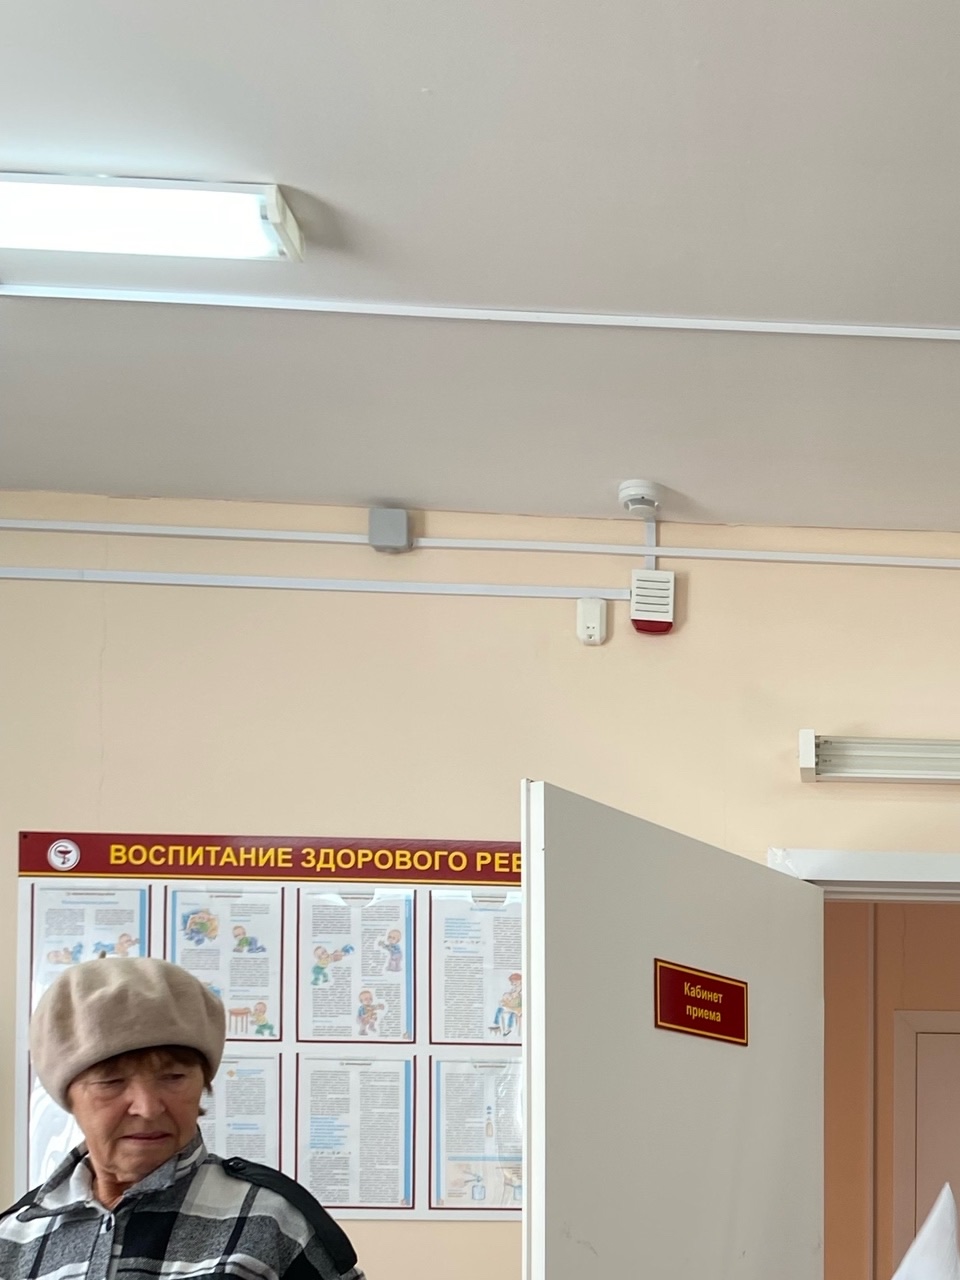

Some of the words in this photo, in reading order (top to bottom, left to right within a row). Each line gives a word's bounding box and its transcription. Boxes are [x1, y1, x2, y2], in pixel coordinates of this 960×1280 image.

[109, 844, 294, 868] ВОСПИТАНИЕ
[301, 847, 468, 873] ЗДОРОВОГО
[684, 981, 723, 1004] Кабинет
[686, 1004, 721, 1022] приема
